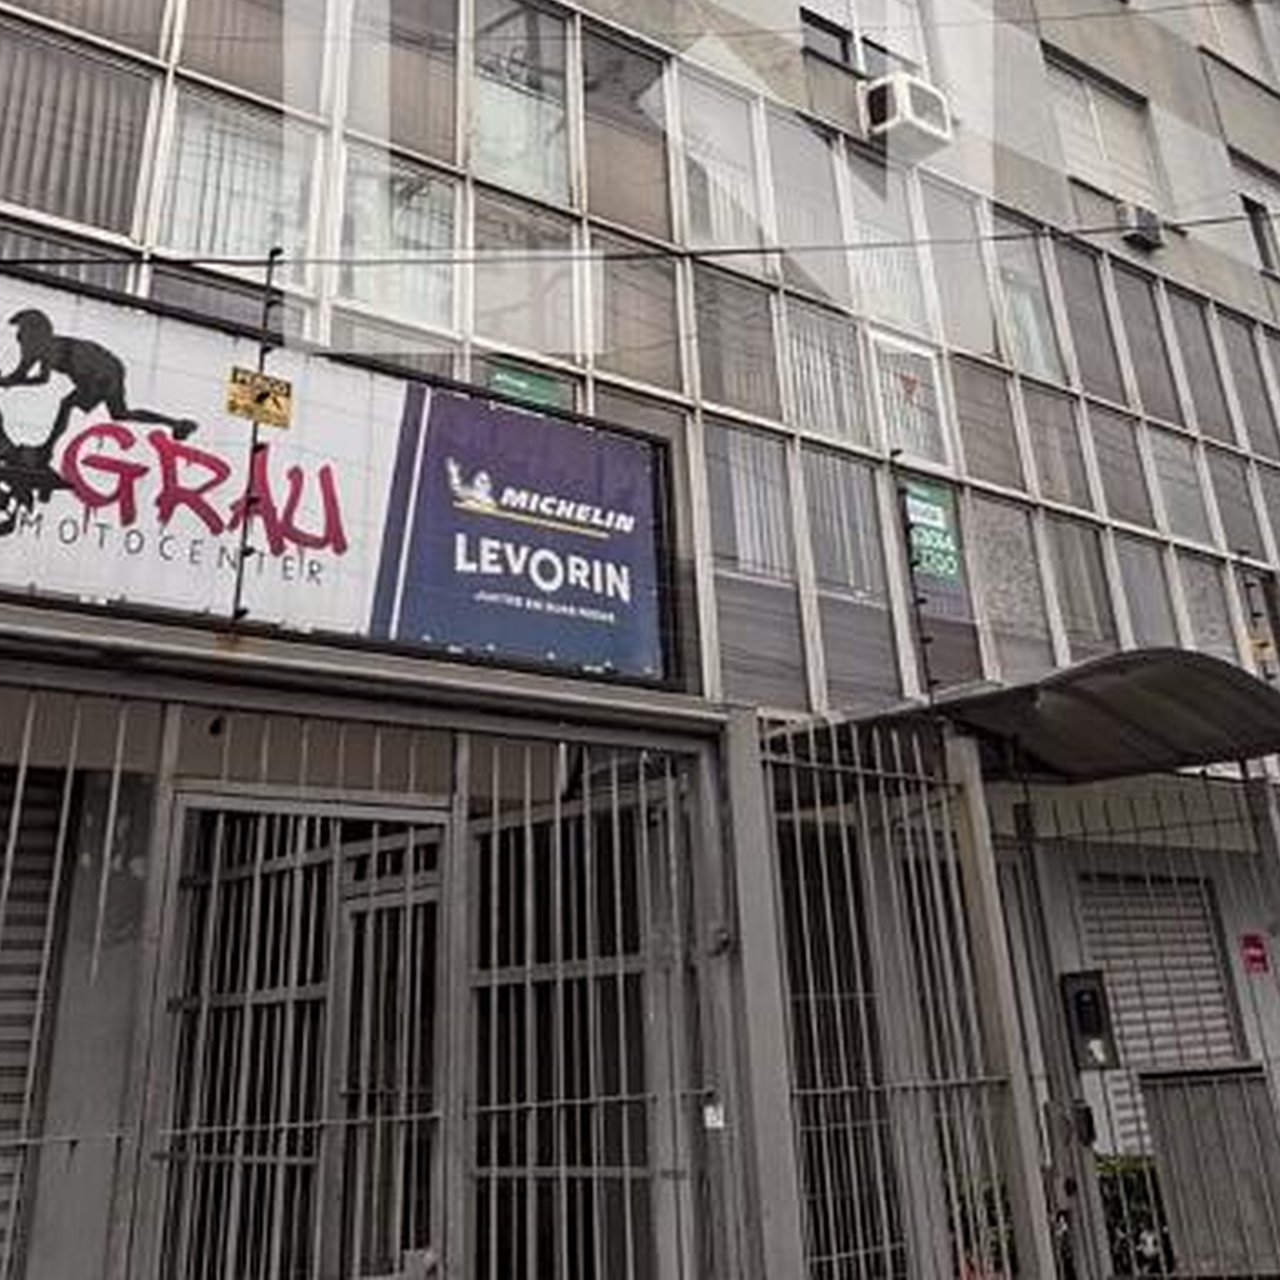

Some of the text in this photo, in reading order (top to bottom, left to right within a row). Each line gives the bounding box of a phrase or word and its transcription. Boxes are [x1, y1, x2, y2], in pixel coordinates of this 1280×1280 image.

[61, 423, 348, 556] GRAU
[501, 486, 635, 533] MICHELIN
[18, 506, 323, 586] MOTOCENTER
[454, 532, 632, 604] LEVORIN
